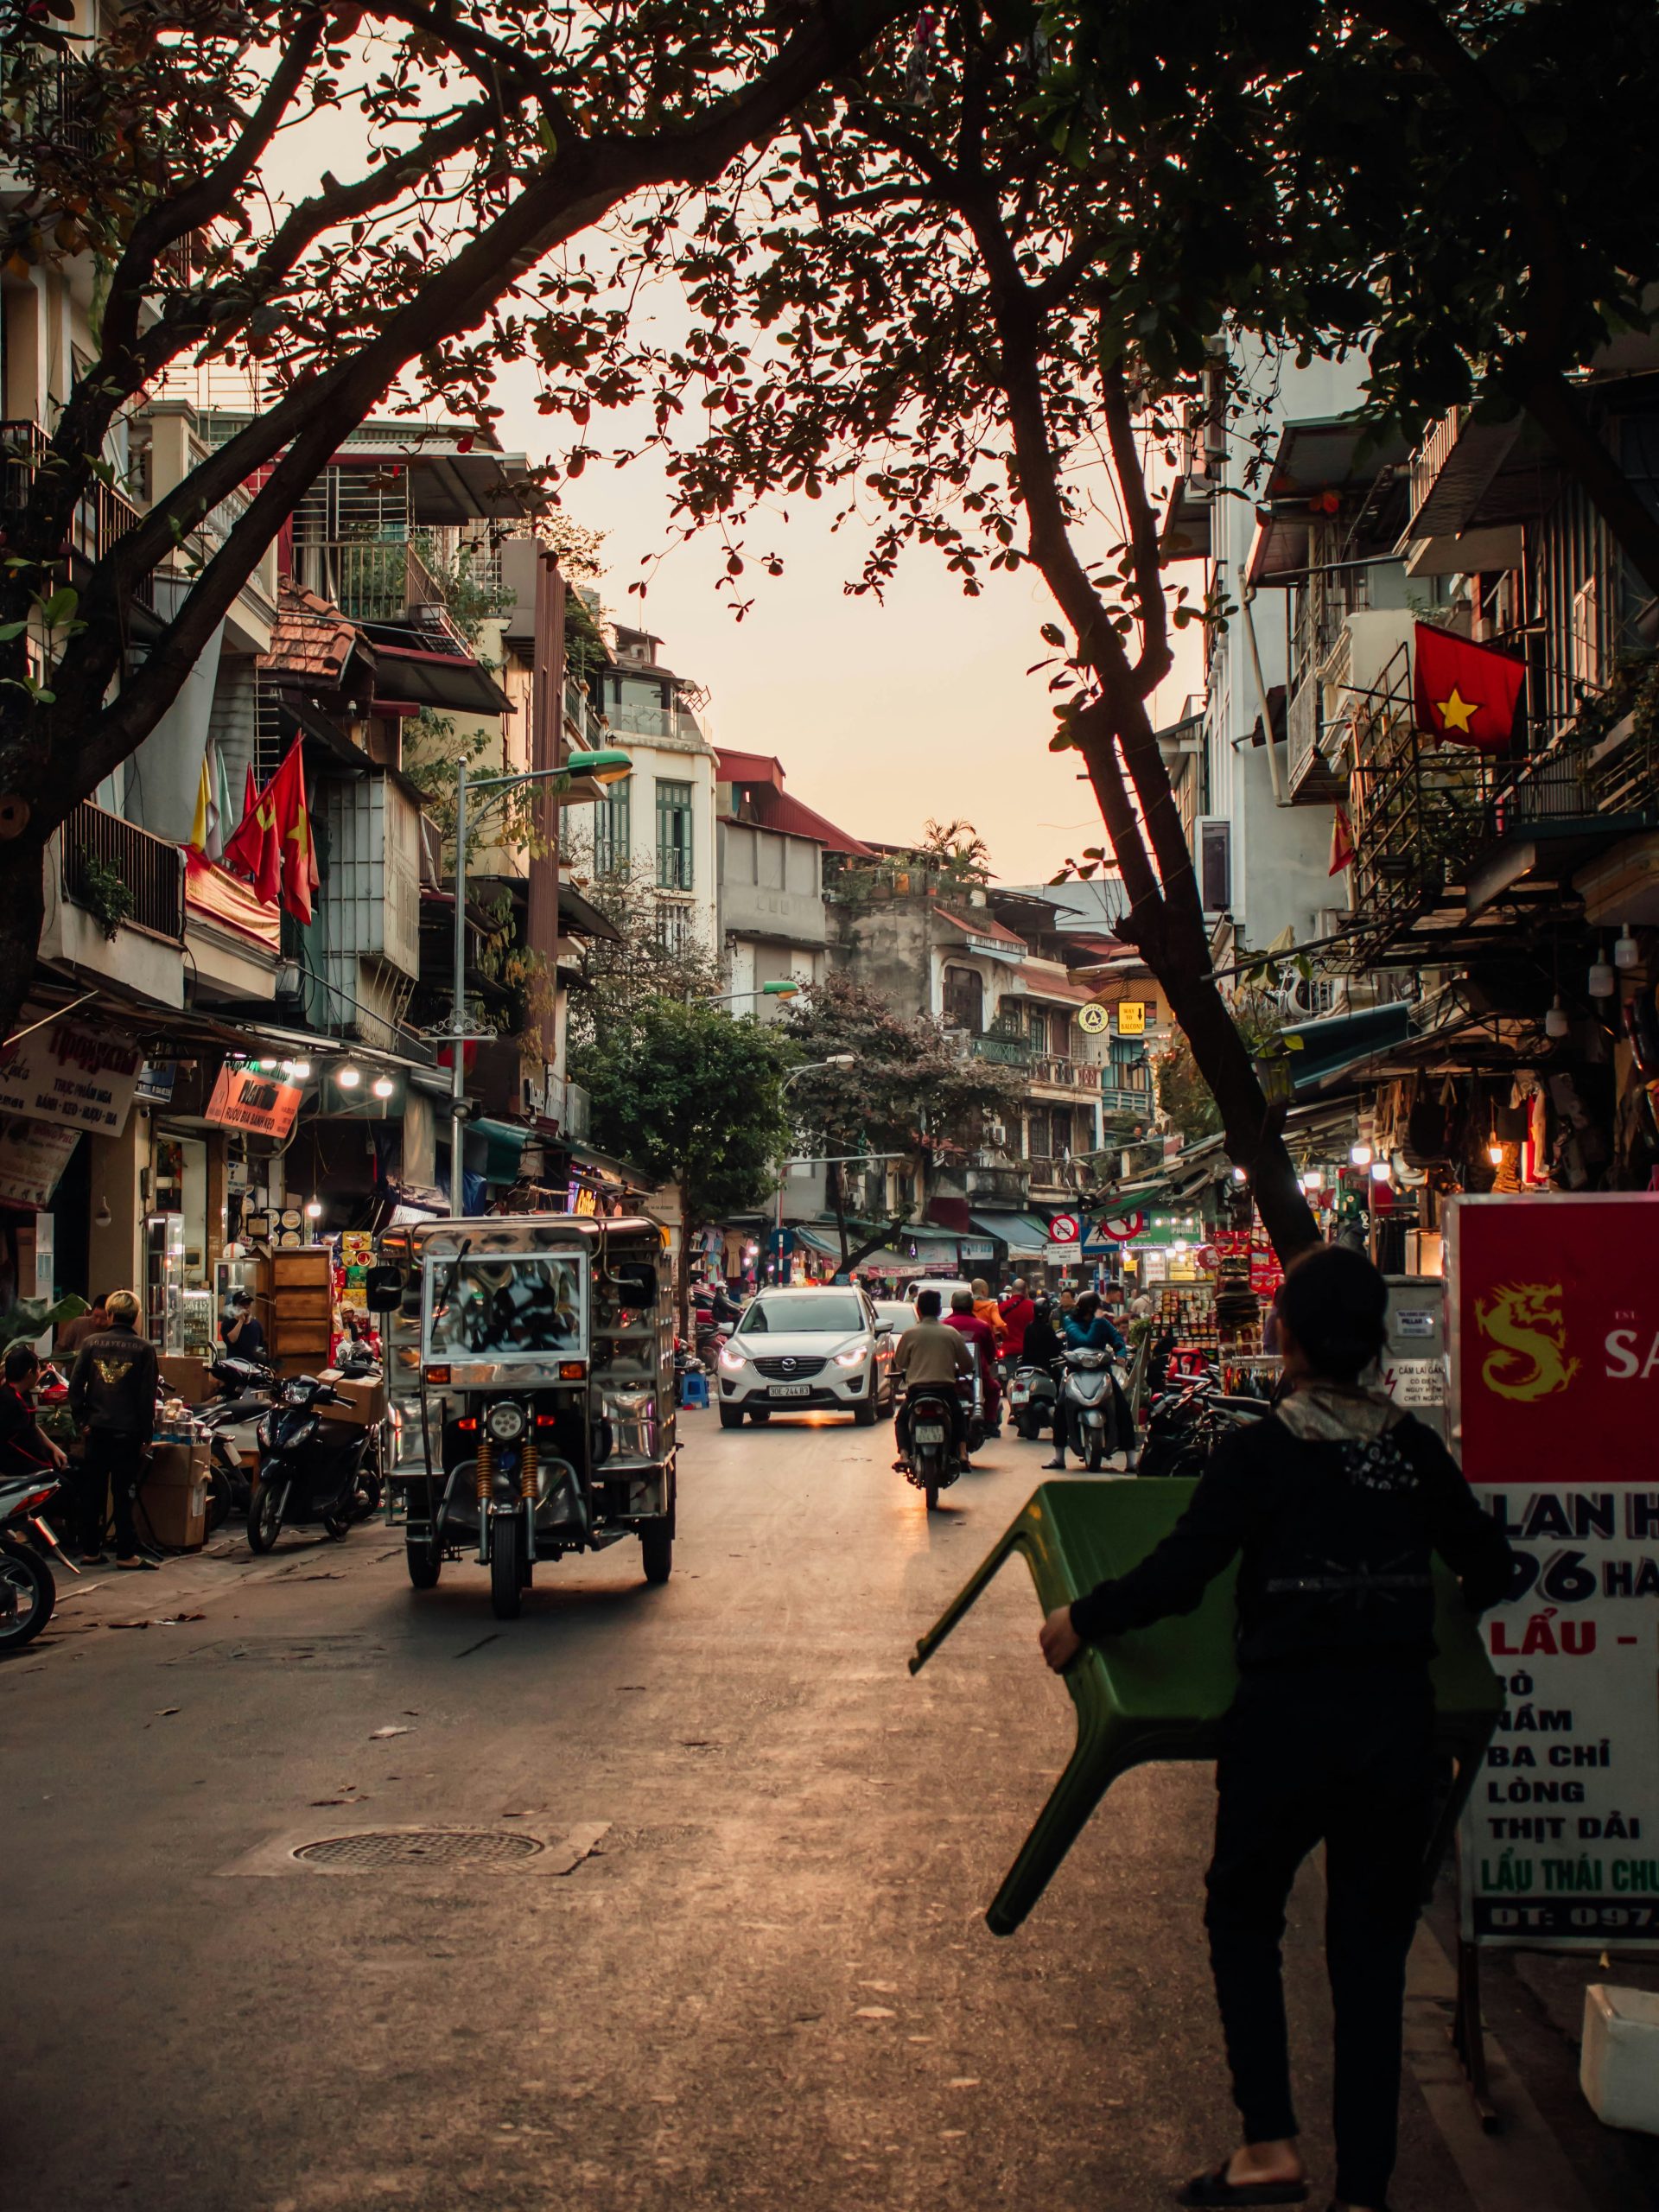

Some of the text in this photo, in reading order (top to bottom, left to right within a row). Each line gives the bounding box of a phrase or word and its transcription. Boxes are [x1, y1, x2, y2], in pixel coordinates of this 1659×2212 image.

[240, 1109, 251, 1123] BIA
[1487, 1493, 1615, 1539] LAN
[1503, 1549, 1597, 1604] 96
[1491, 1607, 1596, 1656] LẨU
[1486, 1738, 1611, 1767] BA CHỈ
[1487, 1776, 1586, 1803] LÒNG
[1487, 1818, 1567, 1843] THỊT
[1481, 1847, 1659, 1891] LẨU THÁI CHU
